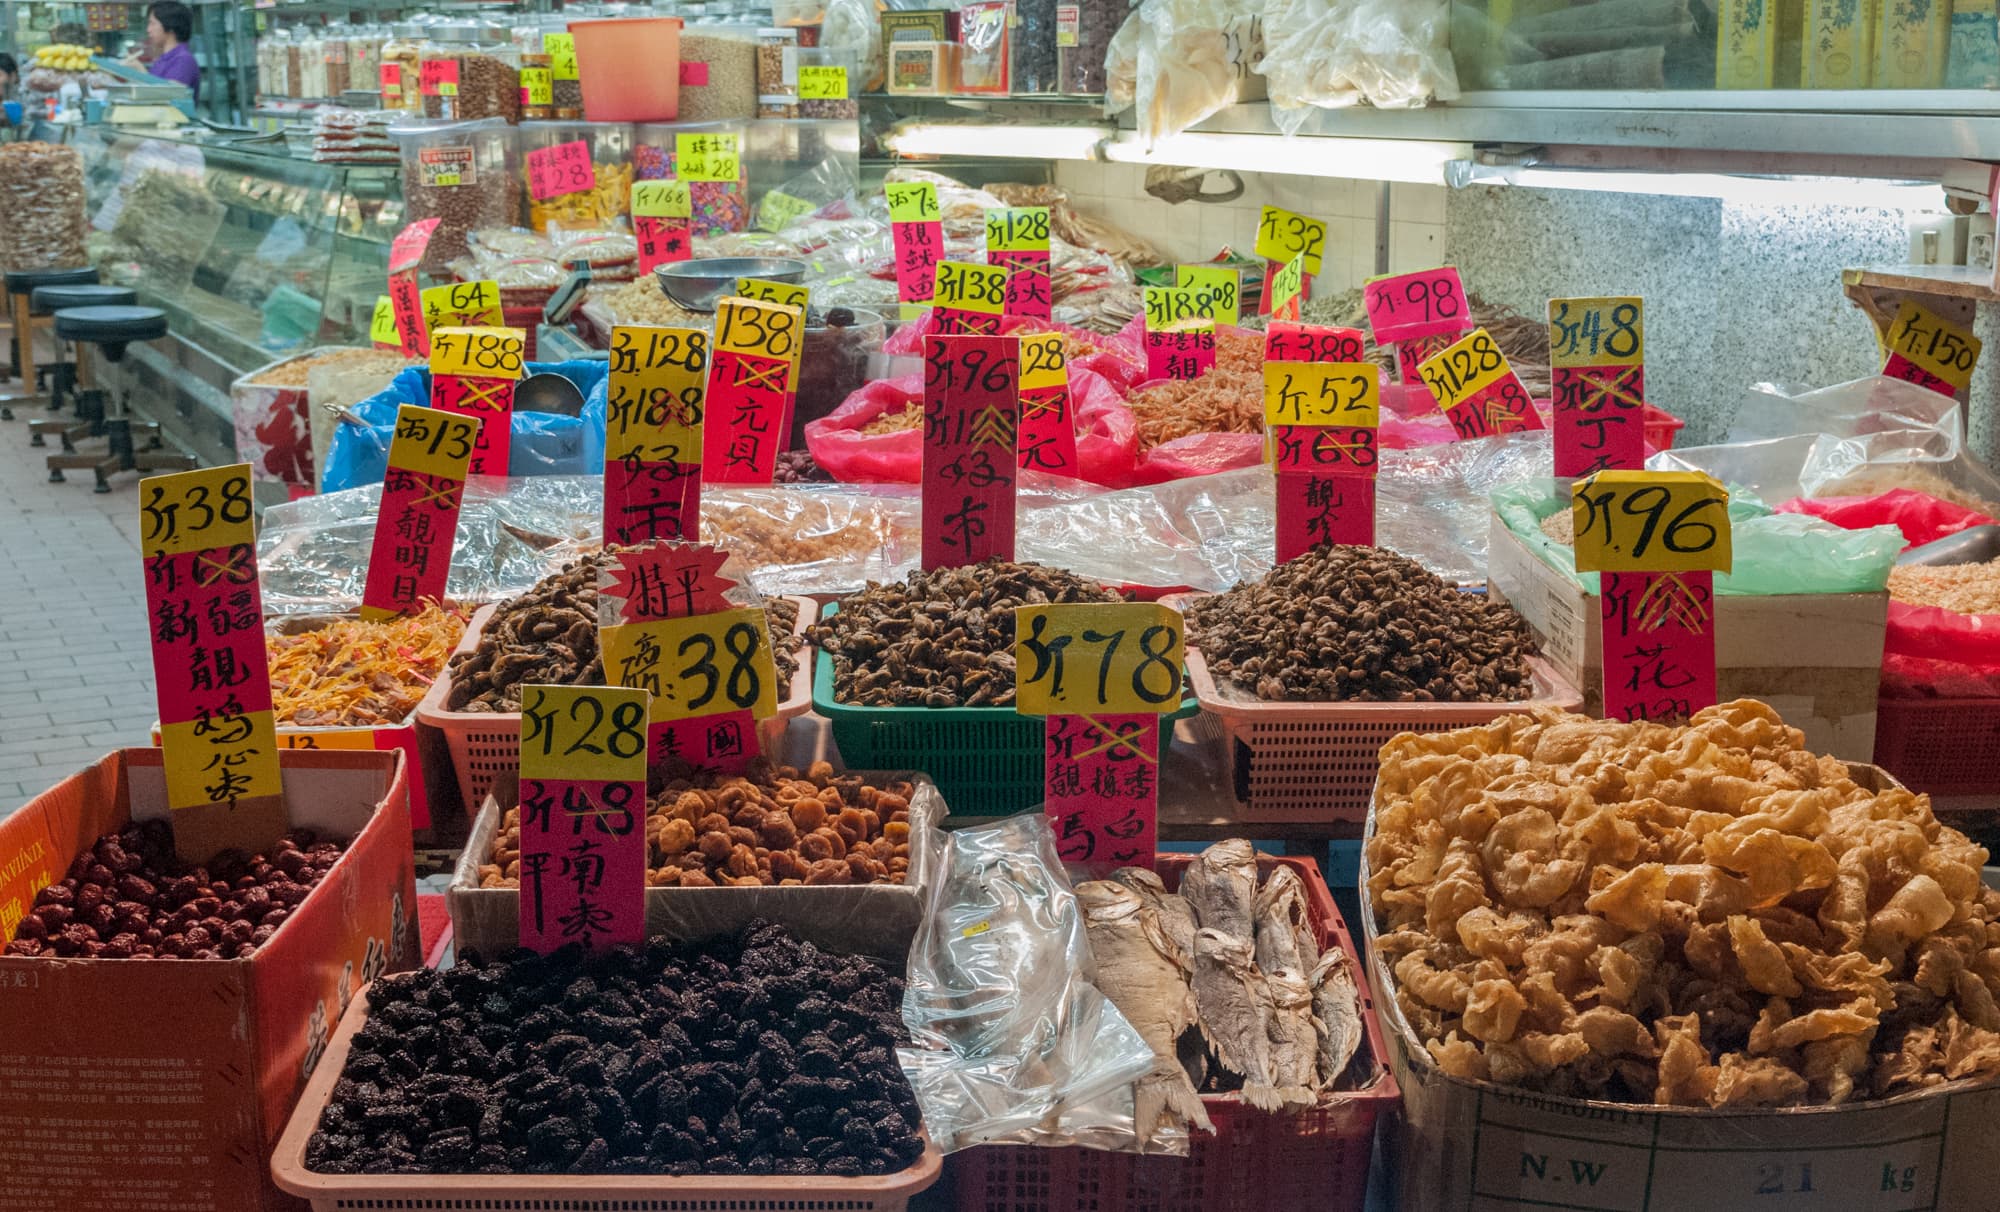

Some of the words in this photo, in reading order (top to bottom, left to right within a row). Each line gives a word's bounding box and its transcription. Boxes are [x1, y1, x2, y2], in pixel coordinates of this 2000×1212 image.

[553, 164, 589, 190] 28
[711, 160, 735, 178] 28
[720, 302, 795, 357] 138
[1879, 1159, 1920, 1193] kg
